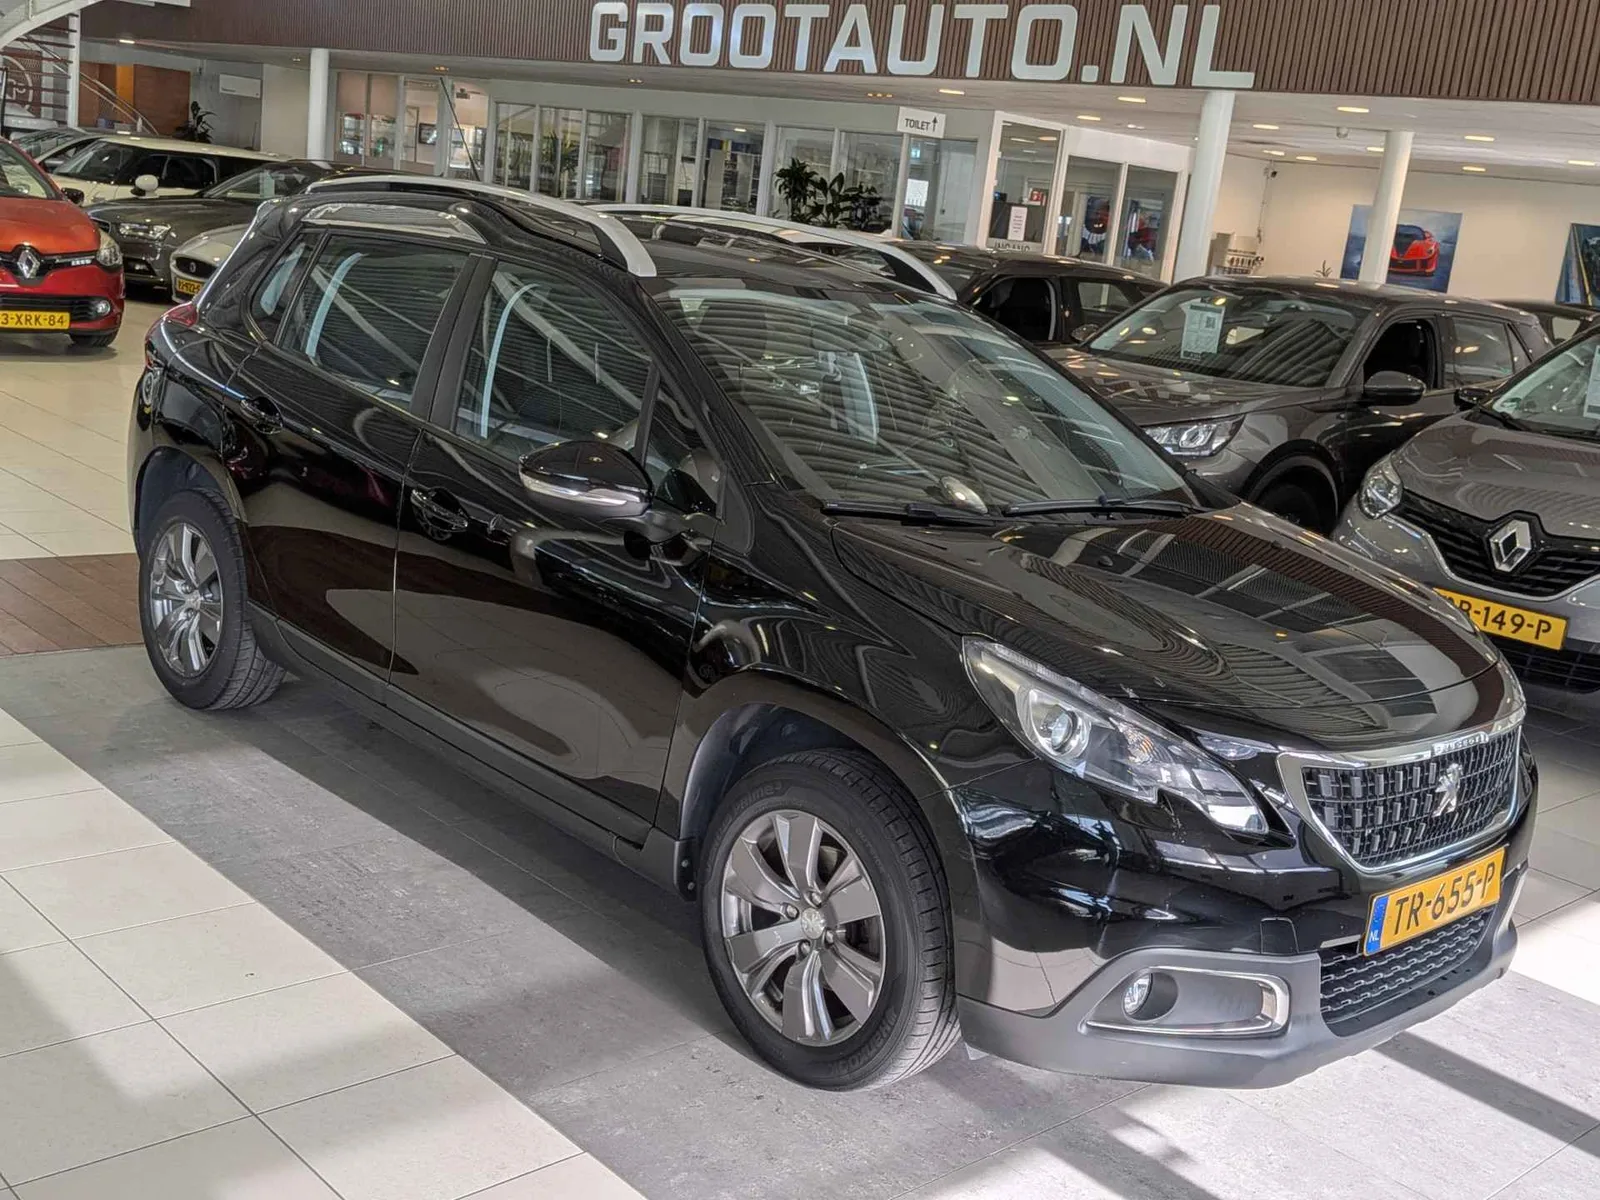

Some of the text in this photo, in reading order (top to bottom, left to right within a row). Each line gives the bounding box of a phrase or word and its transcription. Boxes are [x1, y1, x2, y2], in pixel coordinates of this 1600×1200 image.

[589, 1, 1255, 89] GROOTAUTO.NL
[905, 118, 931, 131] TOILET
[1, 313, 65, 327] 3-XRK-84
[1447, 596, 1552, 640] R-149-P
[1394, 862, 1496, 936] TR-655-P
[1368, 930, 1380, 942] NL
